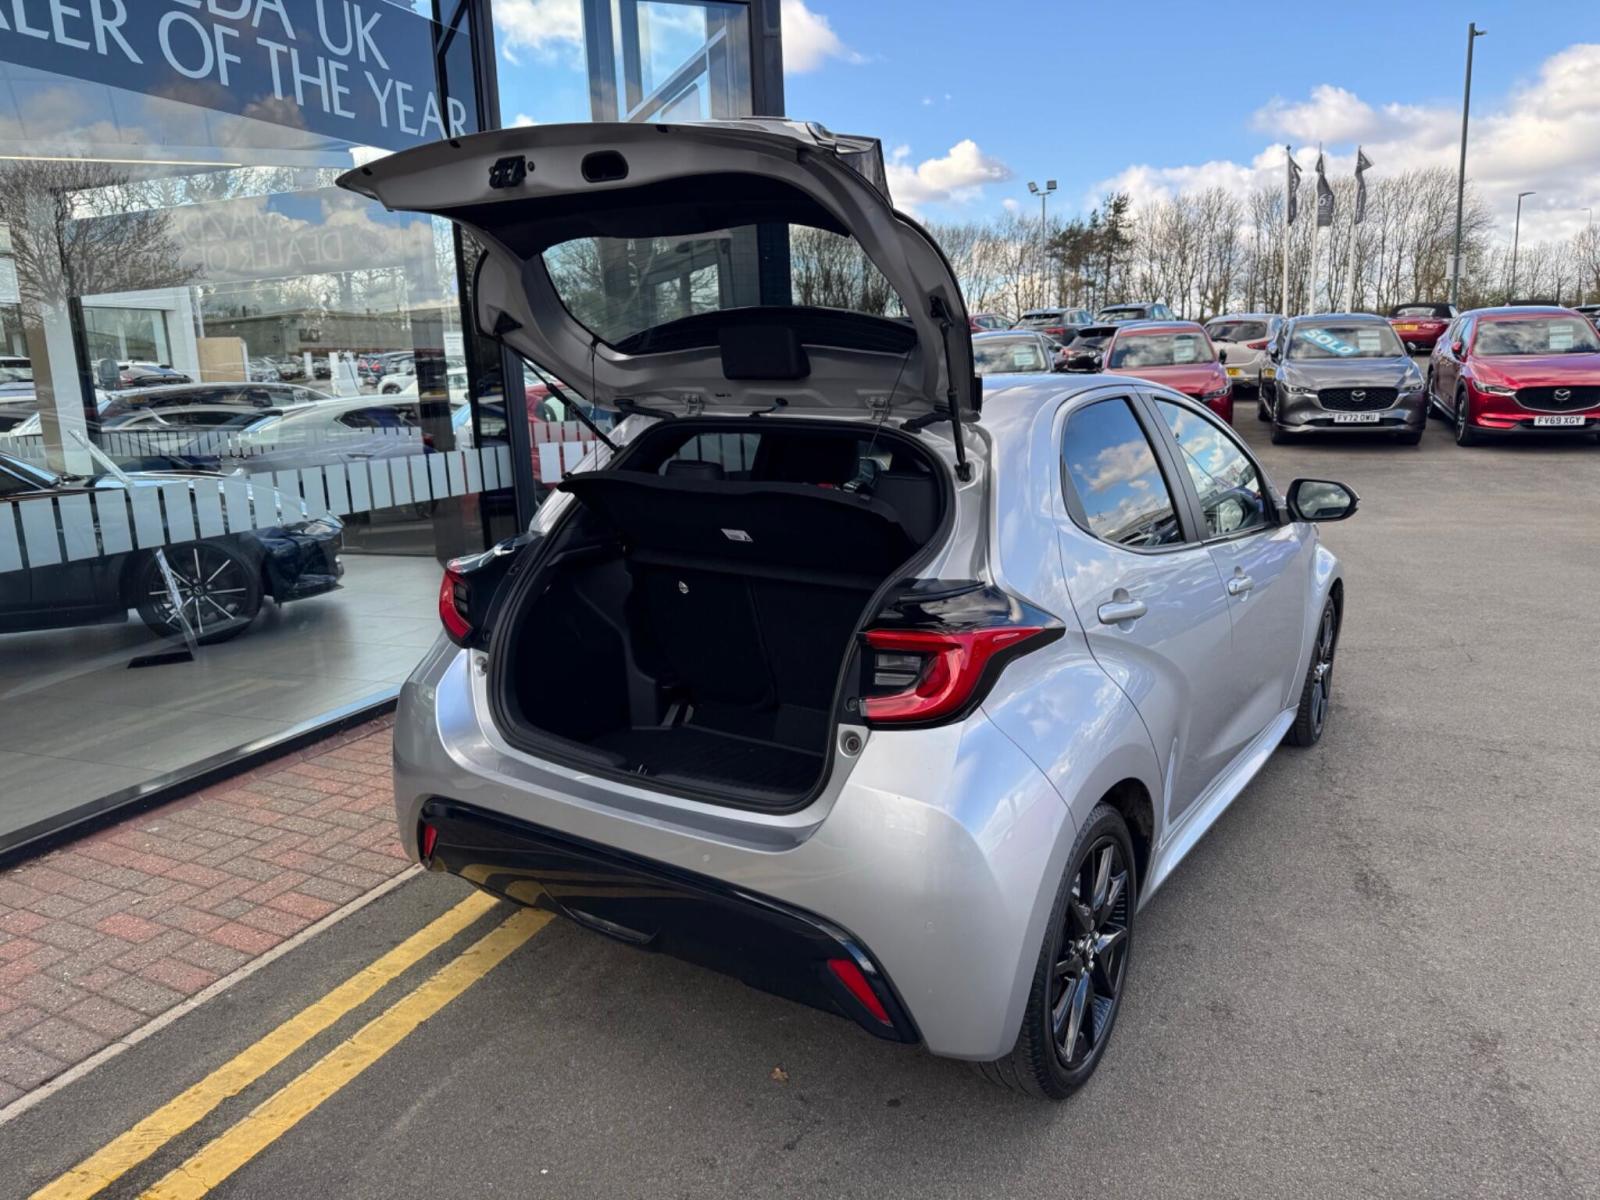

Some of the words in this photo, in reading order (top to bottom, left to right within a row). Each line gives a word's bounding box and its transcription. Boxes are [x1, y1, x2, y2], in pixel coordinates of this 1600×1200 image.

[314, 0, 390, 70] UK
[0, 0, 144, 64] LER
[158, 10, 241, 87] OF
[256, 37, 356, 119] THE
[364, 70, 466, 139] YEAR
[1304, 328, 1354, 354] SOLD
[1537, 416, 1562, 425] FV69
[1563, 416, 1581, 425] XGY
